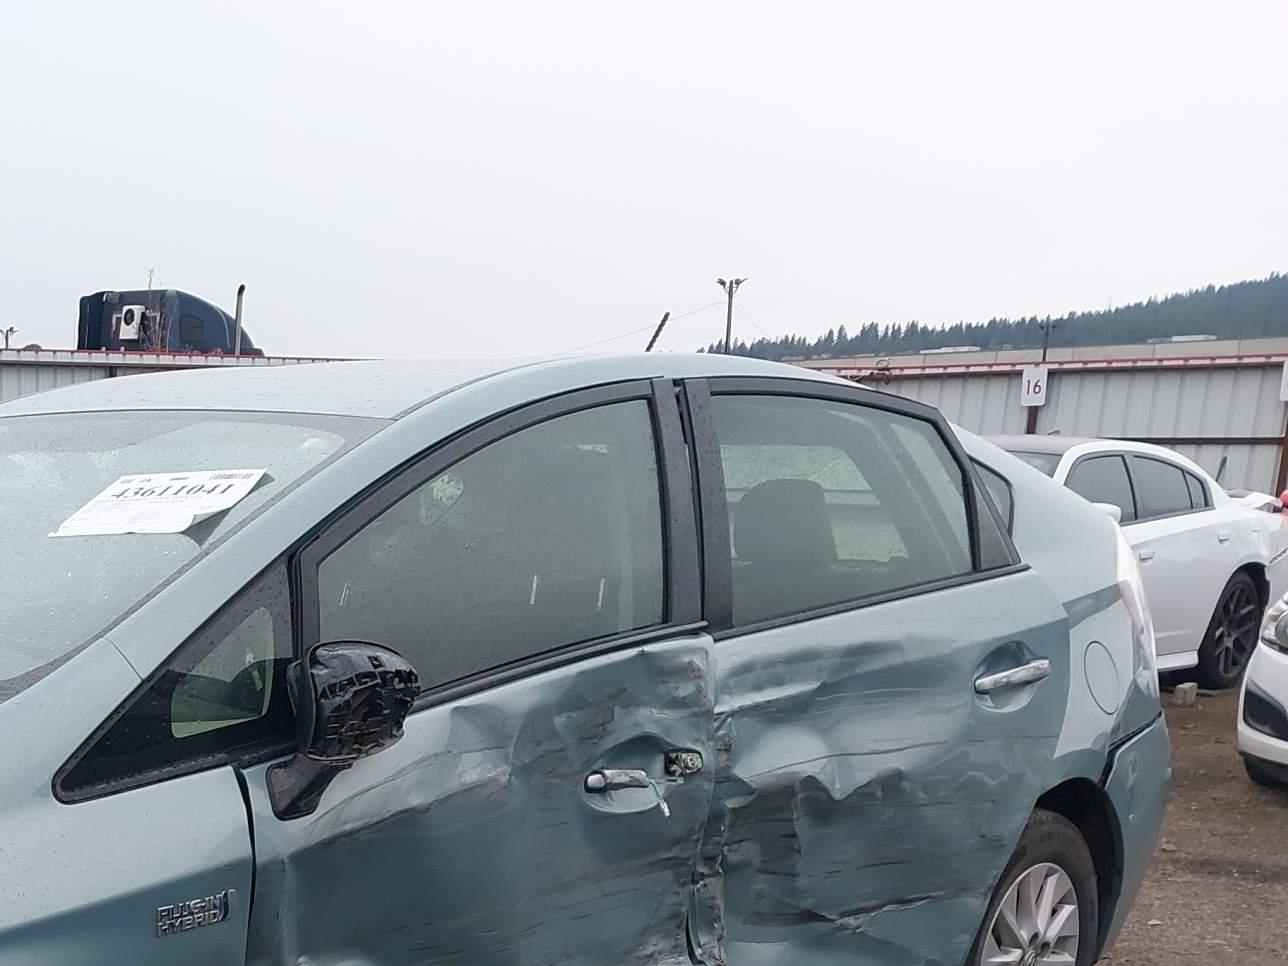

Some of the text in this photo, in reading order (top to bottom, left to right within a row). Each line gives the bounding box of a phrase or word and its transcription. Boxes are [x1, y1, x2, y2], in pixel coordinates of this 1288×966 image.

[1026, 378, 1042, 396] 16
[111, 483, 235, 499] 43611041
[156, 909, 221, 937] HYBRID
